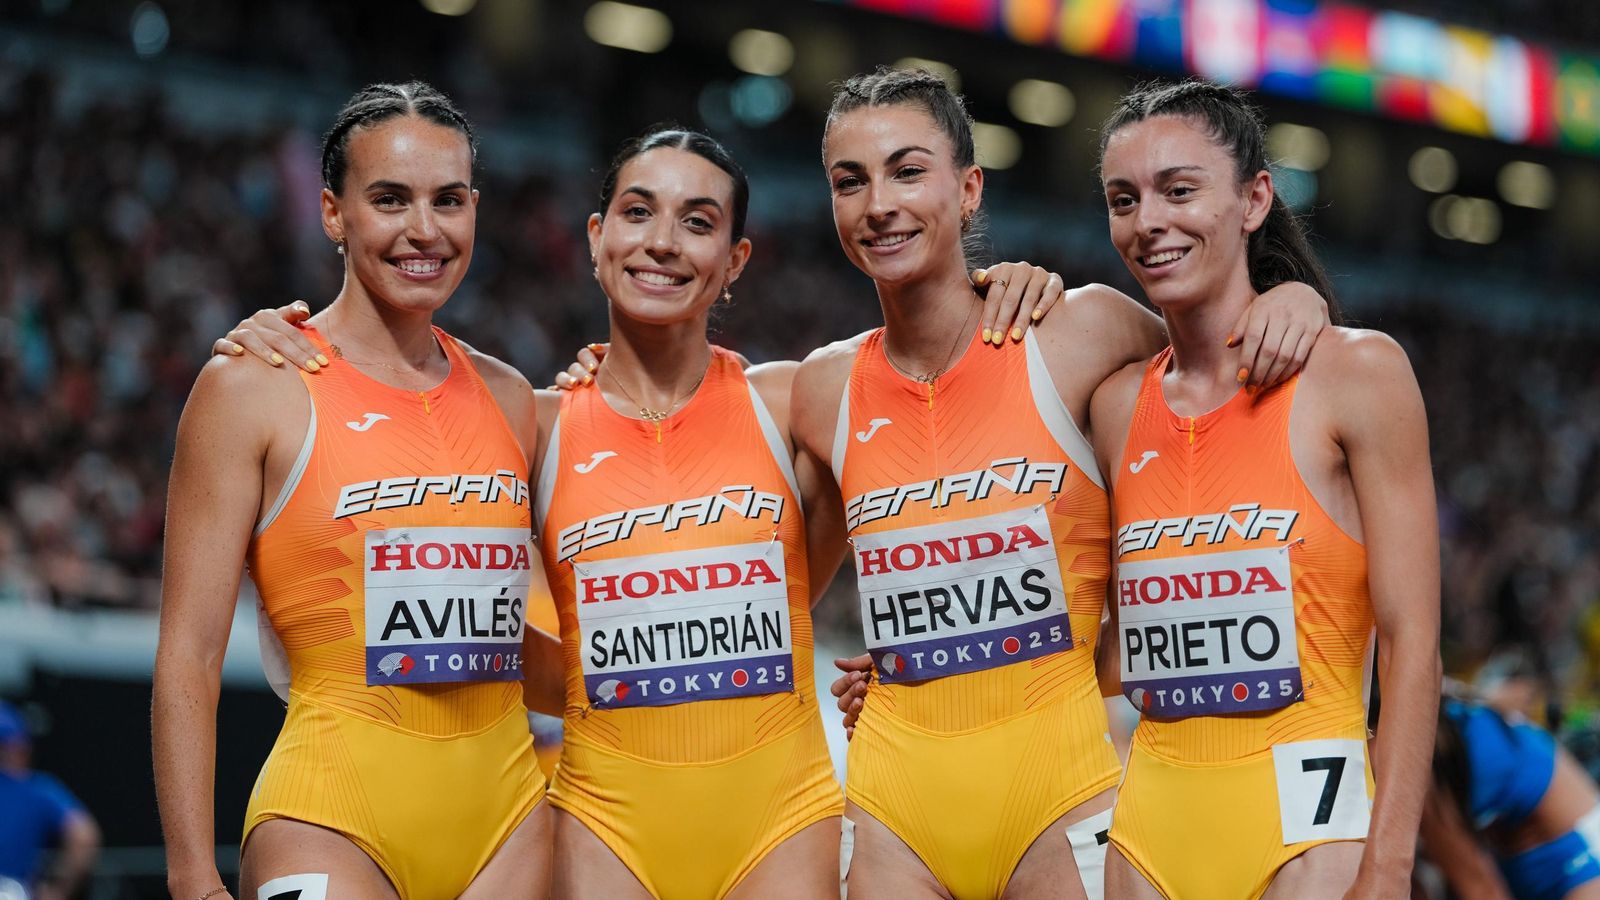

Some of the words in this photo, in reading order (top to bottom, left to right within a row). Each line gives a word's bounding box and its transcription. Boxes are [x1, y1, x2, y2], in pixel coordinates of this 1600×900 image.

[332, 469, 530, 520] ESPAÑA
[846, 456, 1068, 533] ESPAÑA
[556, 484, 785, 564] ESPAÑA
[859, 523, 1049, 577] HONDA
[370, 542, 530, 572] HONDA
[580, 558, 782, 605] HONDA
[380, 587, 522, 641] AVILÉS
[869, 568, 1052, 641] HERVAS
[1119, 566, 1287, 607] HONDA
[590, 602, 783, 669] SANTIDRIÁN
[1125, 614, 1281, 673] PRIETO
[1301, 756, 1347, 826] 7
